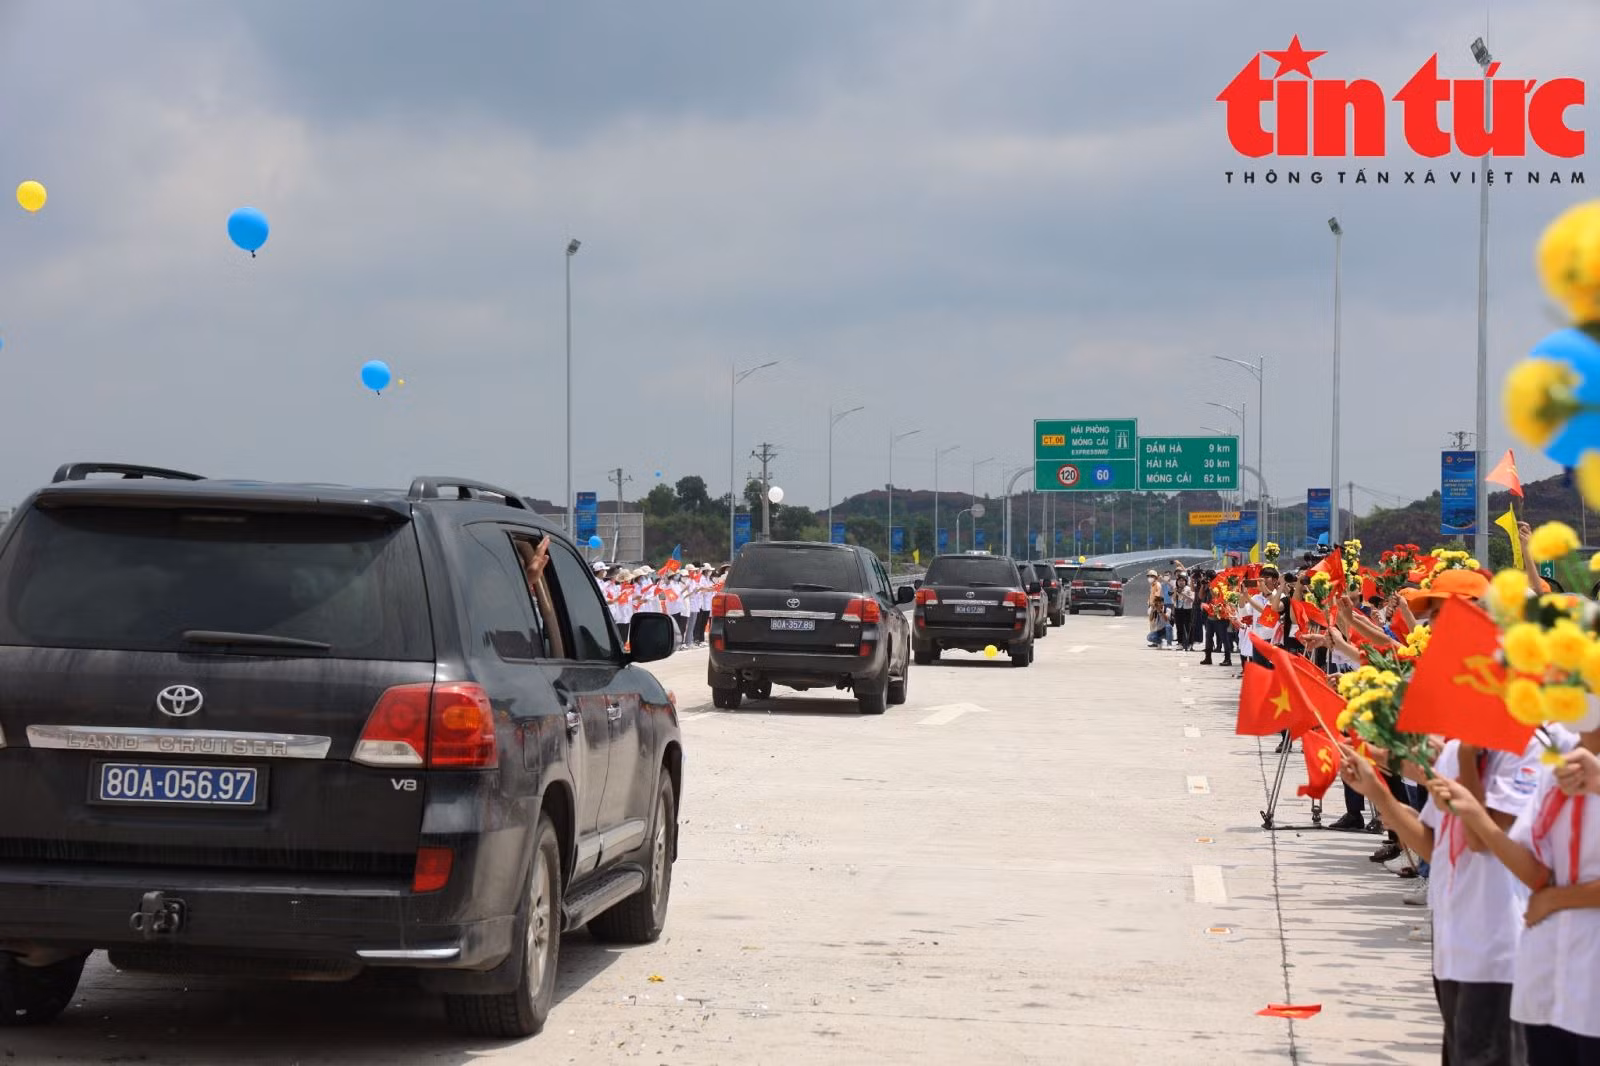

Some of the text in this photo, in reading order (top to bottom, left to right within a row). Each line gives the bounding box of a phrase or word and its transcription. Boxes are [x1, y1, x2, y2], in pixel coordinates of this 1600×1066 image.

[1085, 424, 1110, 434] PHÒNG
[1071, 436, 1093, 446] MÓNG
[1169, 442, 1183, 453] HÀ
[1208, 443, 1215, 453] 9
[1217, 443, 1230, 453] km
[1165, 457, 1179, 468] HÀ
[1203, 459, 1214, 468] 30
[1217, 459, 1230, 468] km
[1060, 470, 1076, 481] 120
[1096, 469, 1109, 481] 60
[1146, 471, 1173, 483] MÓNG
[1203, 474, 1214, 483] 62
[1217, 474, 1230, 483] km
[66, 733, 289, 756] LAND CRUISER
[106, 768, 252, 800] 80A-056.97
[391, 777, 418, 792] V8
